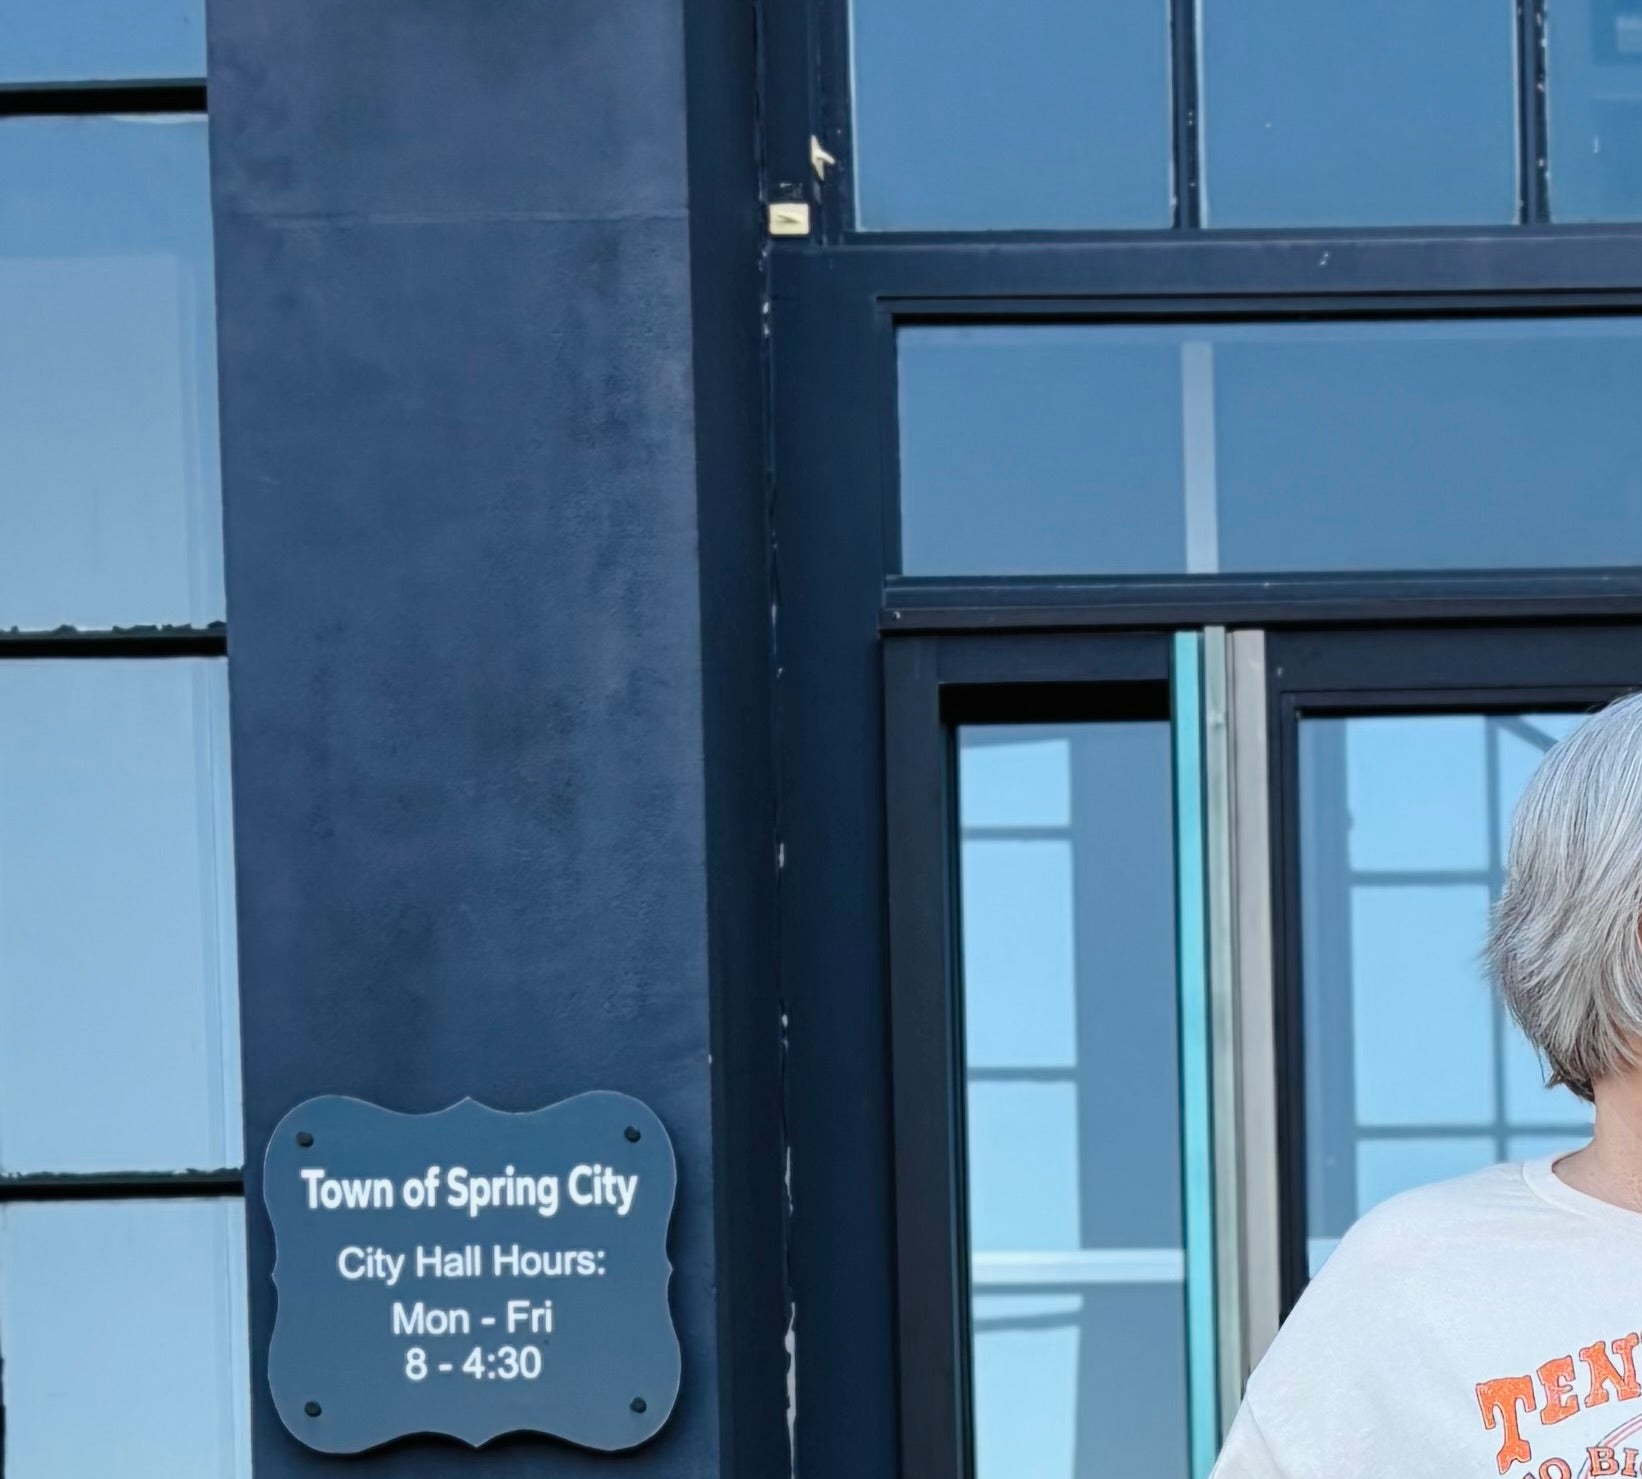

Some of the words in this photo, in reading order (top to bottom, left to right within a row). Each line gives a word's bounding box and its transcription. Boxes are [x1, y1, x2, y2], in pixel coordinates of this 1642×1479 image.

[300, 1168, 394, 1209] Town
[402, 1166, 440, 1206] of
[447, 1165, 559, 1217] Spring
[568, 1163, 639, 1215] City
[337, 1246, 405, 1285] City
[416, 1245, 481, 1277] Hall
[493, 1244, 606, 1275] Hours:
[392, 1302, 470, 1334] Mon
[506, 1300, 553, 1333] Fri
[404, 1347, 427, 1380] 8
[462, 1345, 542, 1379] 4:30
